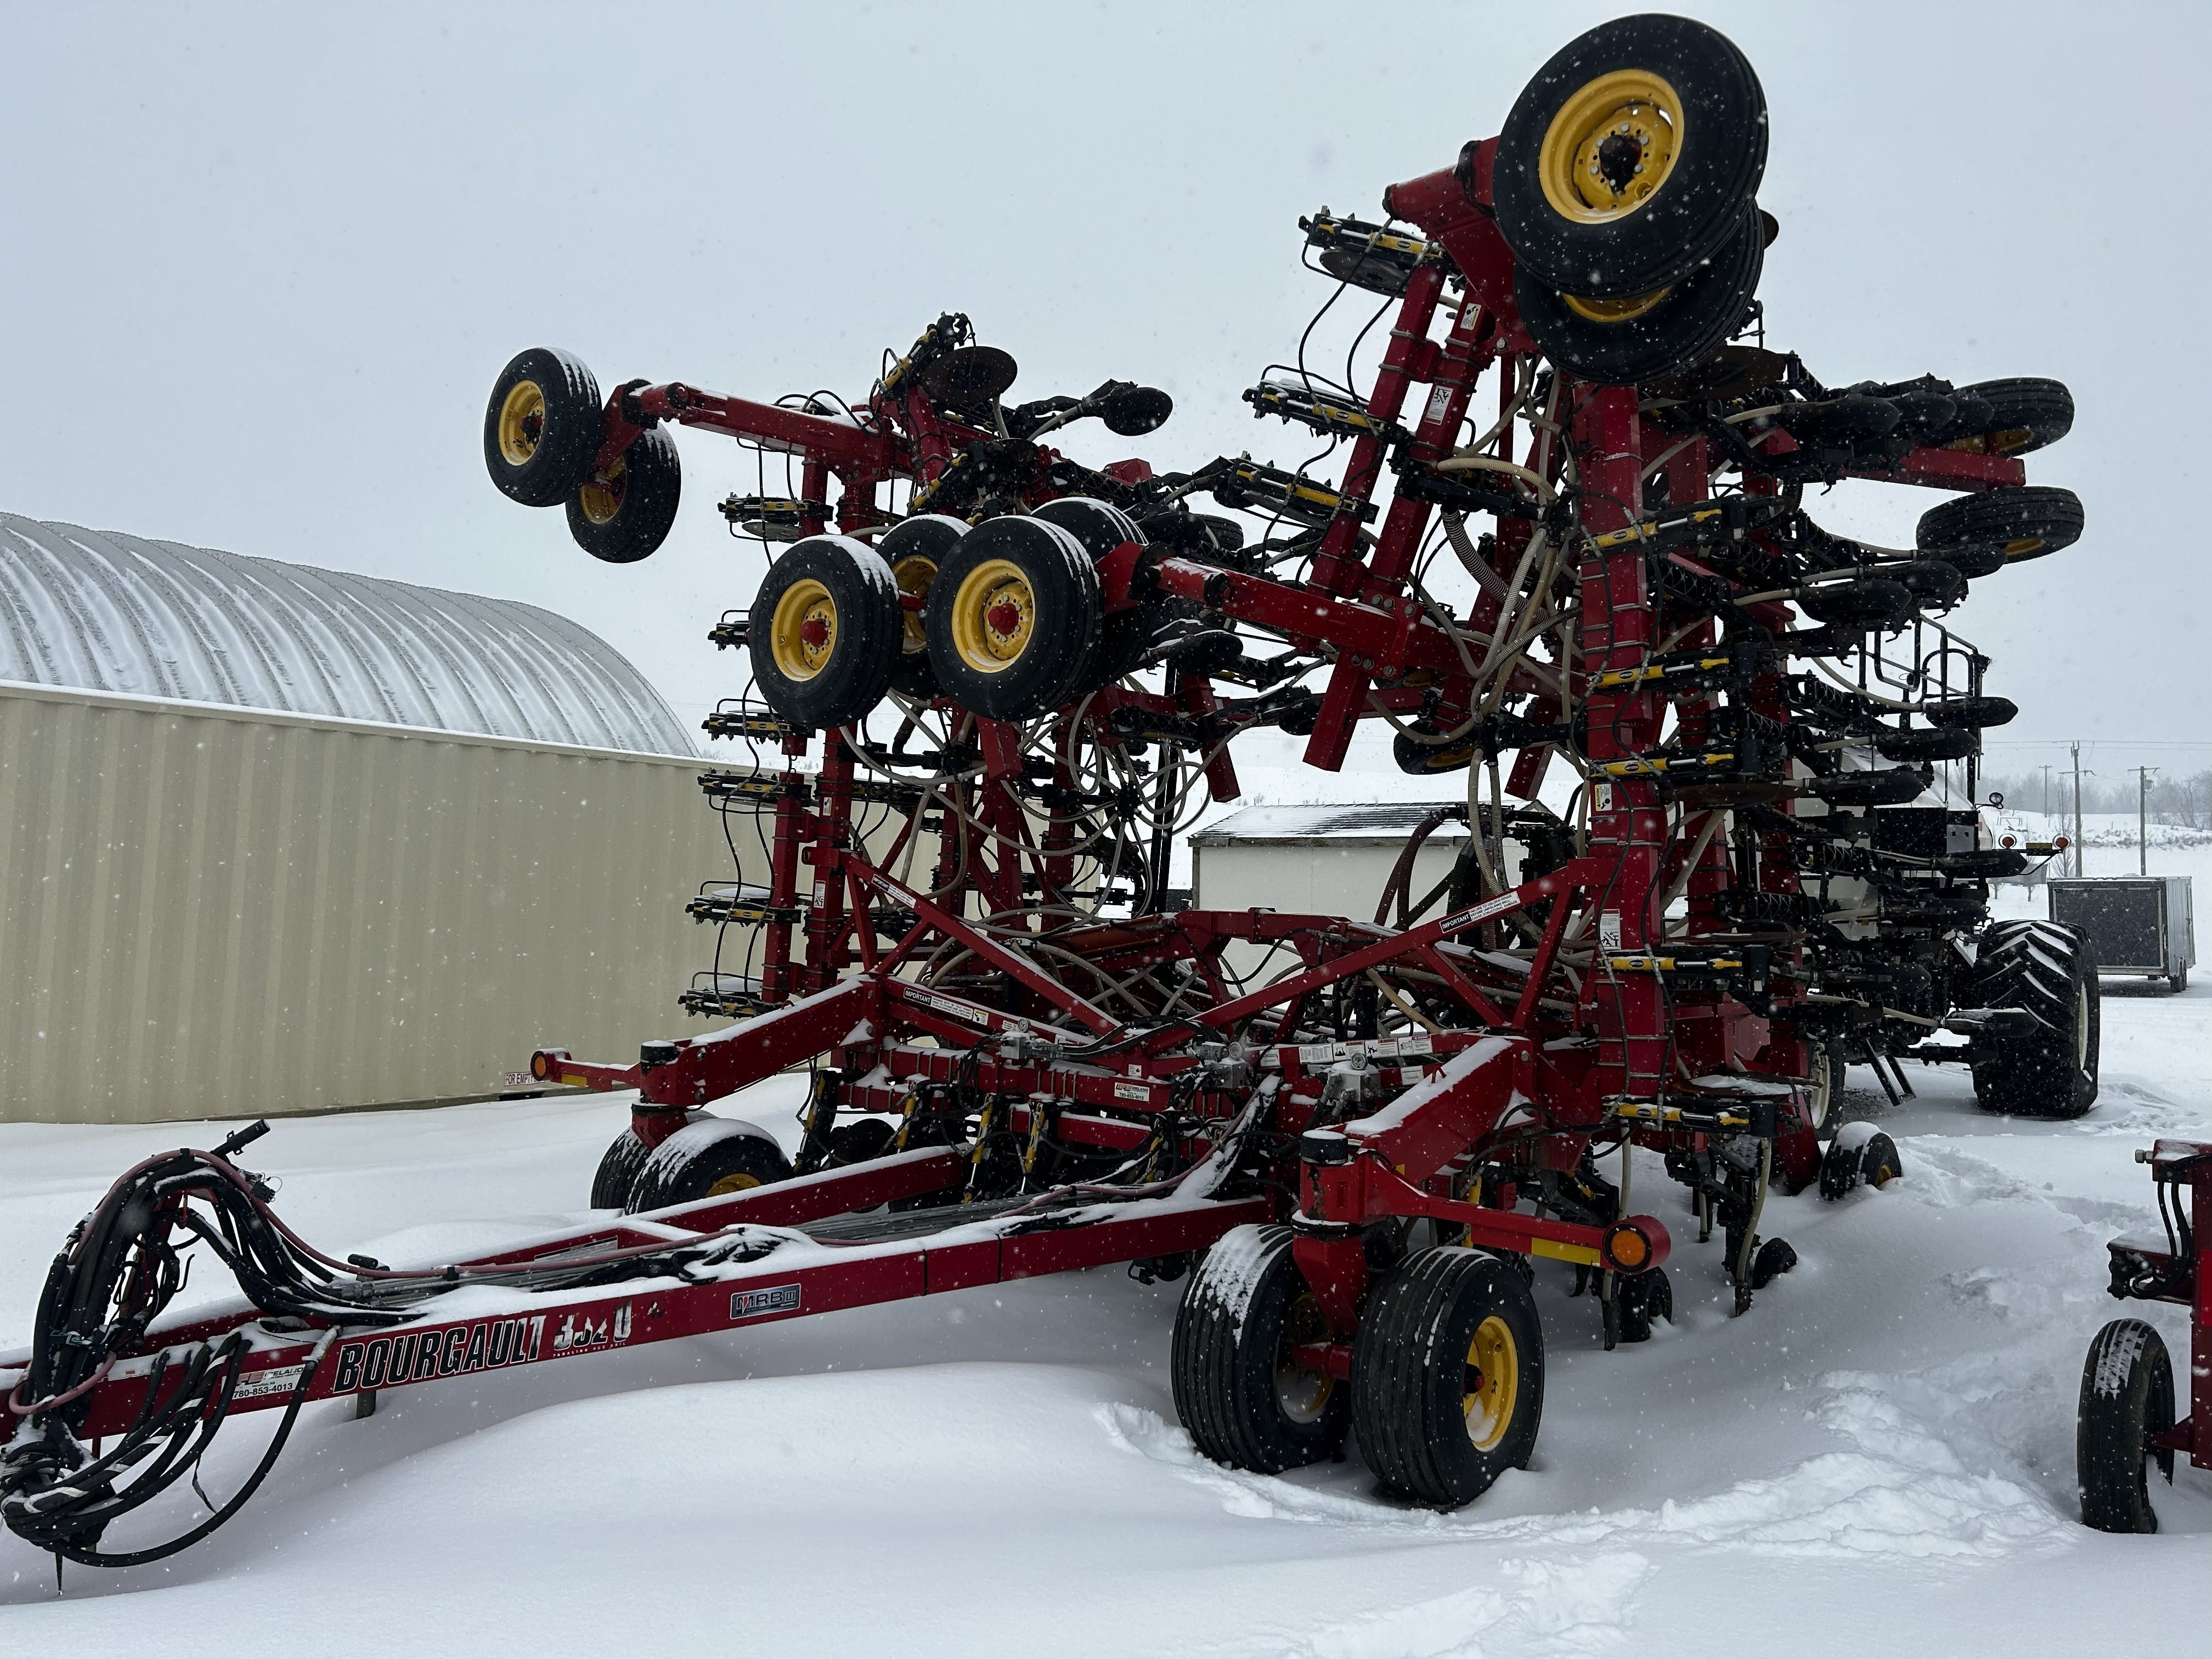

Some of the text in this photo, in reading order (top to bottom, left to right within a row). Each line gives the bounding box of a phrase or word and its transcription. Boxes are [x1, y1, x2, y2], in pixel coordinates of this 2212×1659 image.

[1442, 913, 1469, 929] IMPORTANT
[905, 990, 931, 1003] IMPORTANT
[506, 1074, 515, 1084] FOR
[332, 1314, 546, 1393] BOURGAULT
[233, 1383, 293, 1398] 780-853-4013
